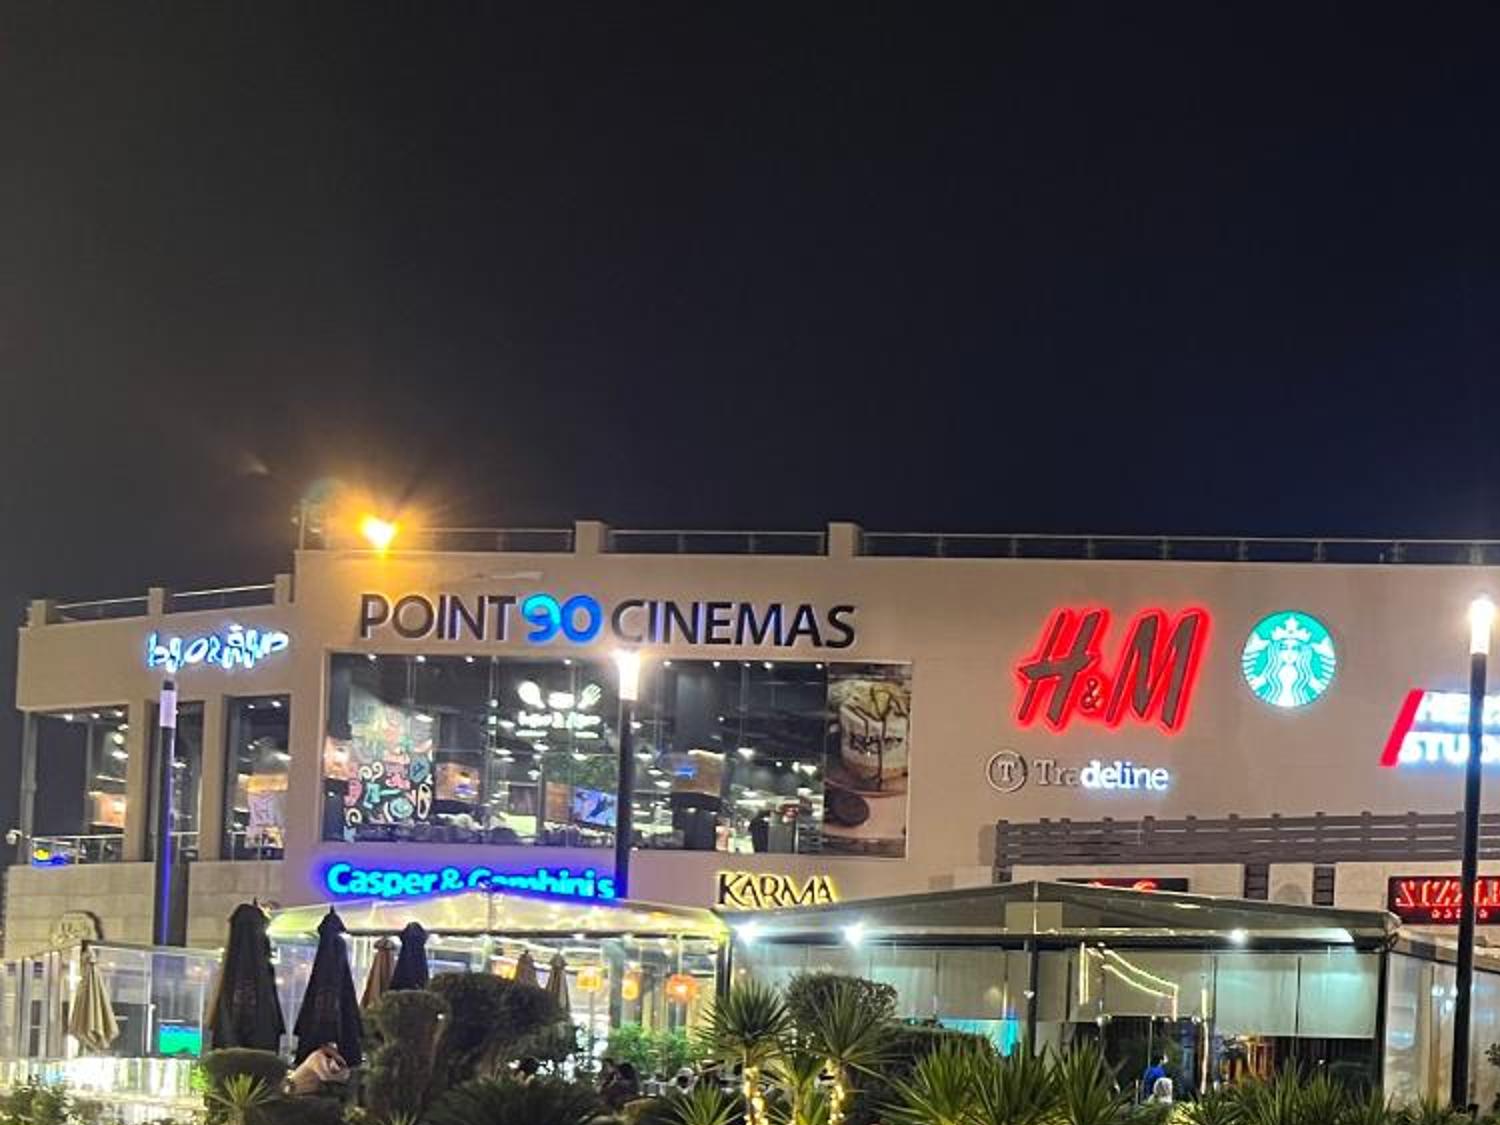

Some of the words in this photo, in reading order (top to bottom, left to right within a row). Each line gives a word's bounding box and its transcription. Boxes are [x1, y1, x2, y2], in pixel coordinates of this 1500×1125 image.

[360, 594, 516, 640] POINT
[521, 593, 601, 644] 90
[611, 599, 857, 649] CINEMAS
[1014, 606, 1204, 731] H&M
[1033, 759, 1171, 790] Tradeline
[327, 863, 438, 897] Casper
[440, 867, 465, 890] &
[716, 870, 835, 908] KARMA
